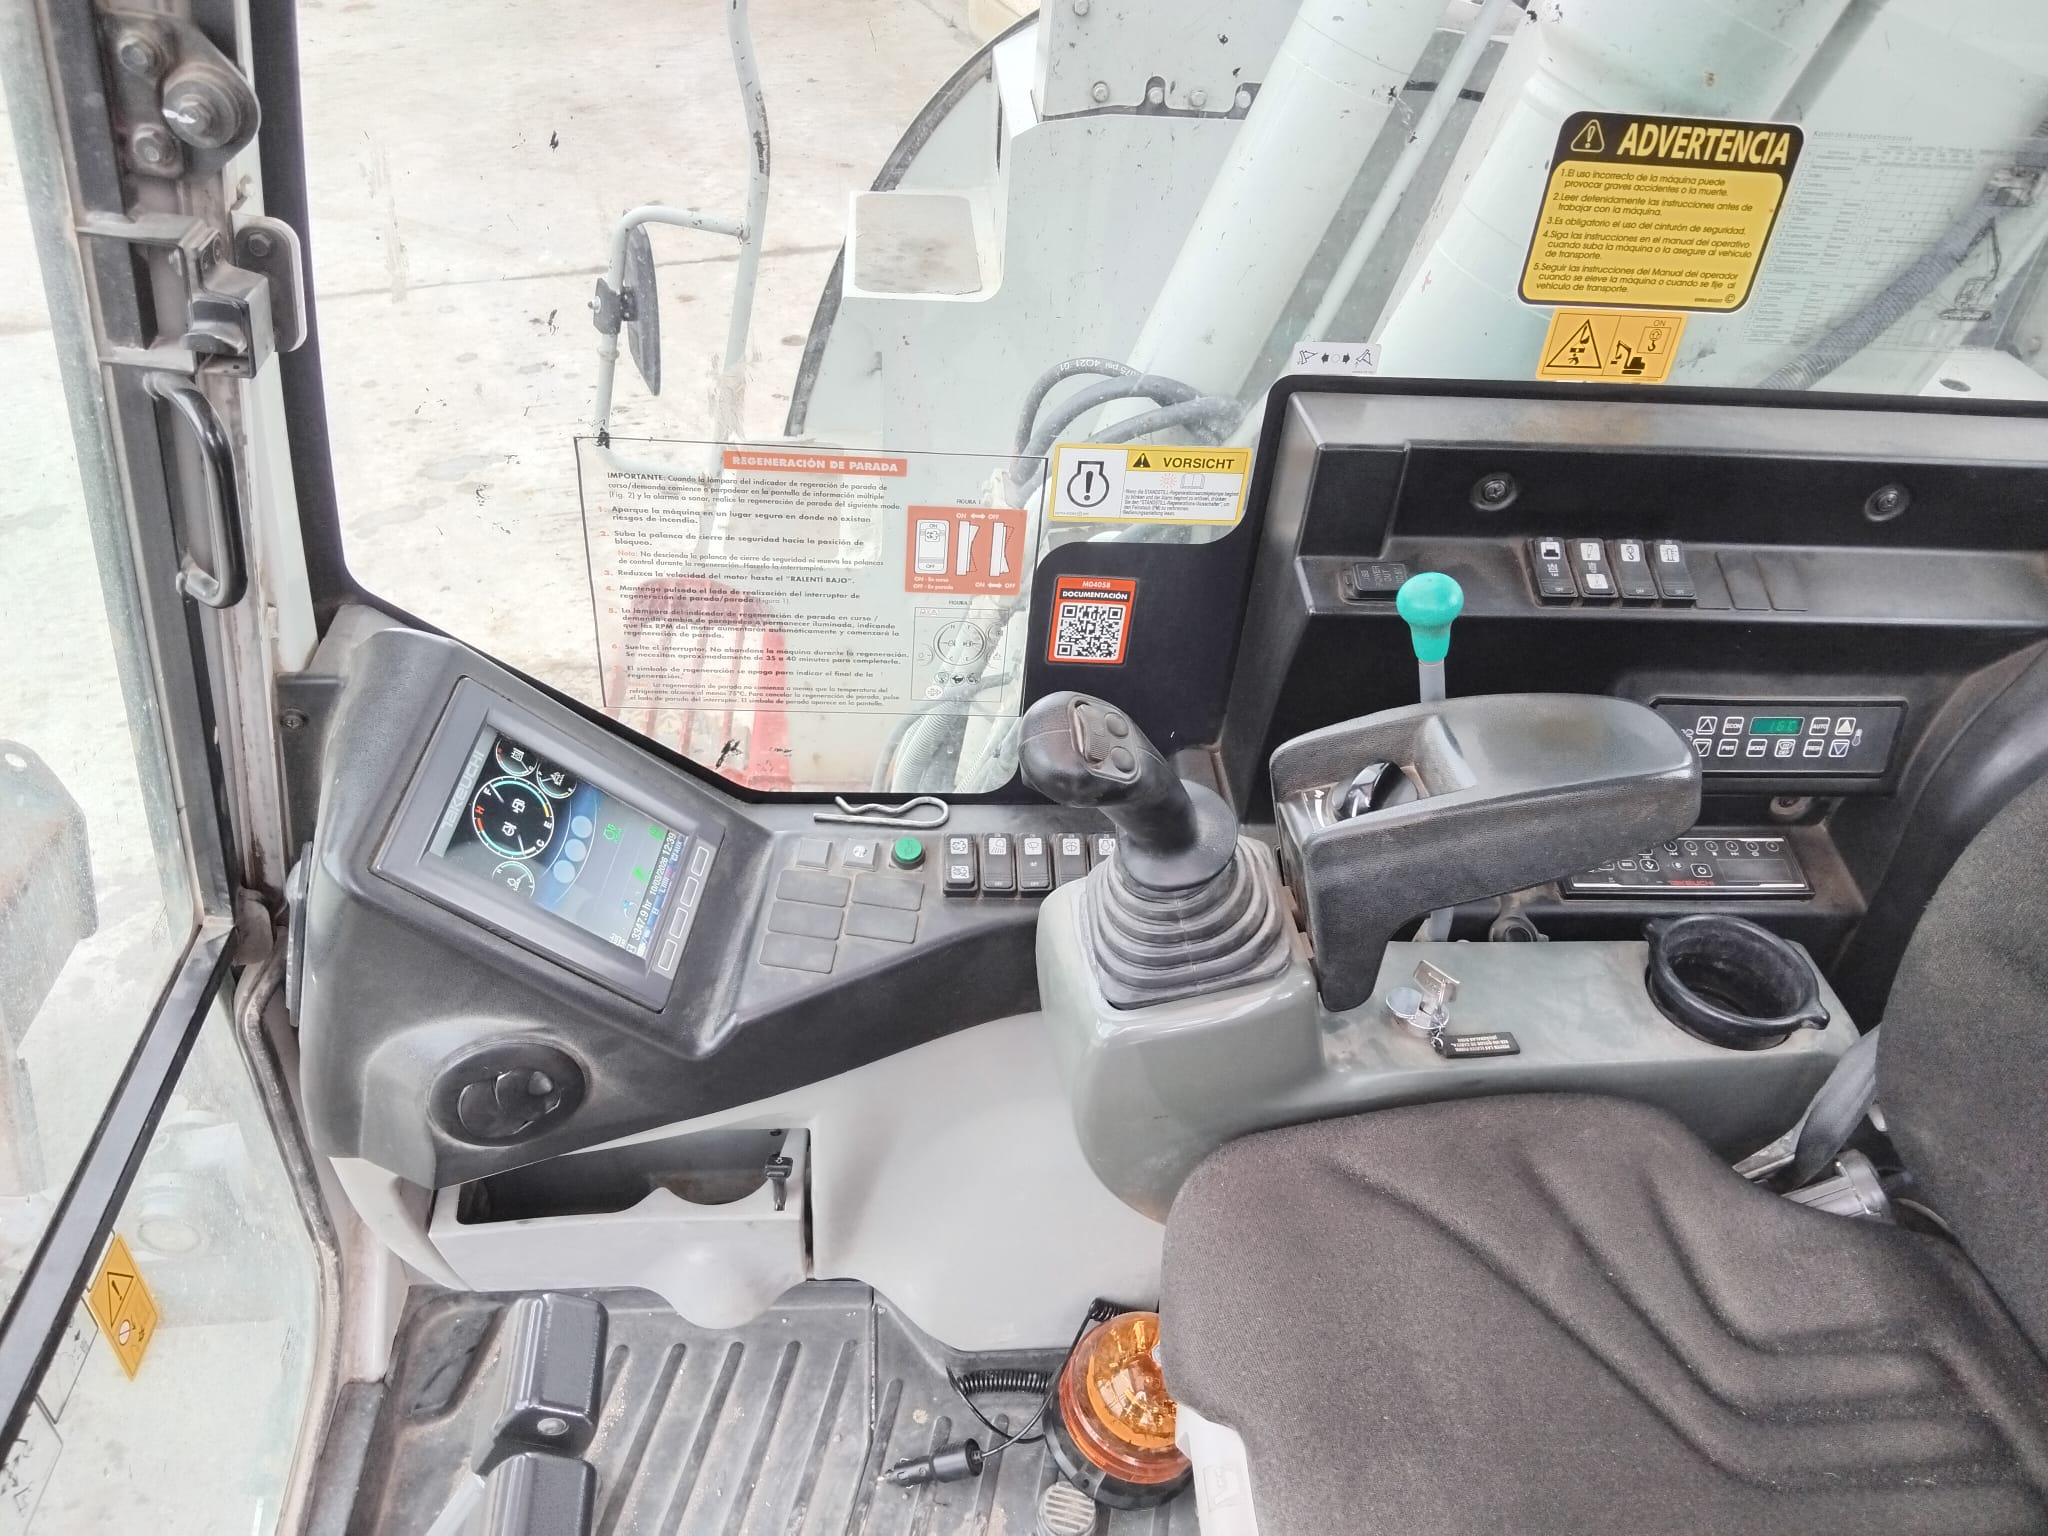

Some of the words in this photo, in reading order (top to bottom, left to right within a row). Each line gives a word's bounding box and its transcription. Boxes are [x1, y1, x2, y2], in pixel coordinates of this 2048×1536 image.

[1616, 122, 1791, 165] ADVERTENCIA
[732, 456, 825, 469] REGENERACIÓN
[830, 460, 845, 470] DE
[849, 462, 898, 472] PARADA
[1163, 457, 1235, 469] VORSICHT
[1063, 591, 1127, 600] DOCUMENTACIÓN
[663, 832, 677, 855] 12:39
